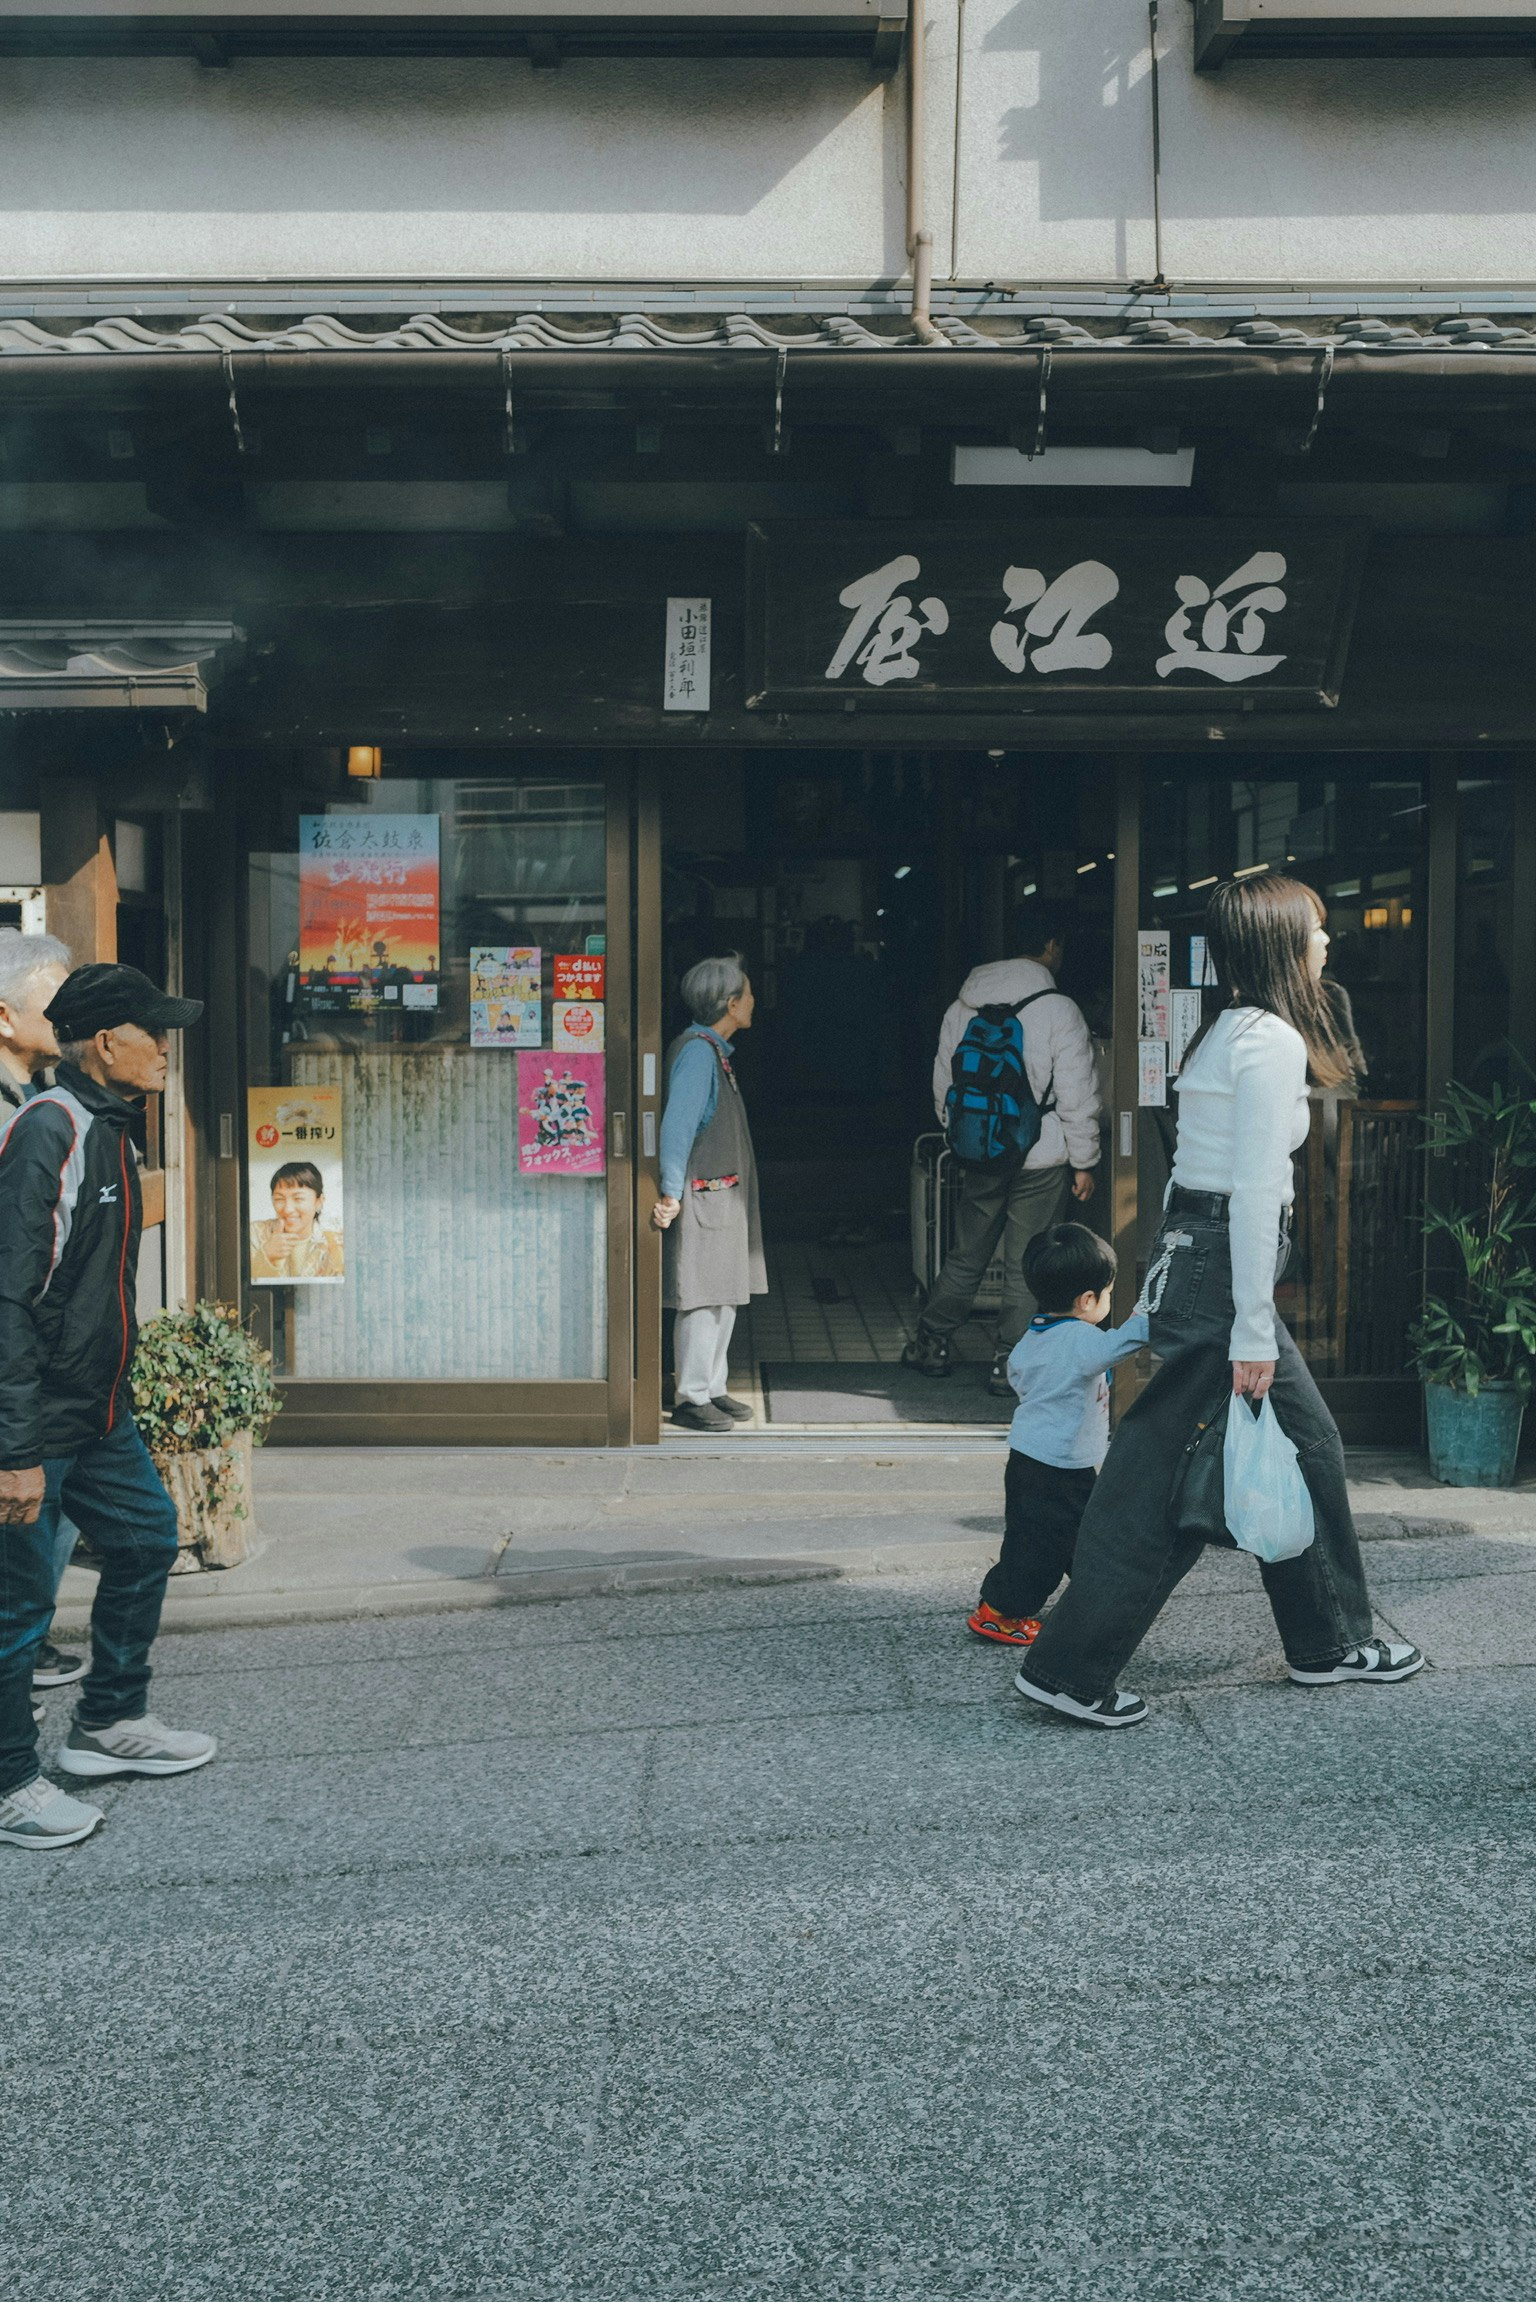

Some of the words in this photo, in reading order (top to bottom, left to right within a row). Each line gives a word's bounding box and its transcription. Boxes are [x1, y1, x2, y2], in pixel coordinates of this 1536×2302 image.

[825, 551, 1288, 686] 近江屋
[557, 973, 602, 983] つかえます
[281, 1126, 335, 1140] 一番搾り
